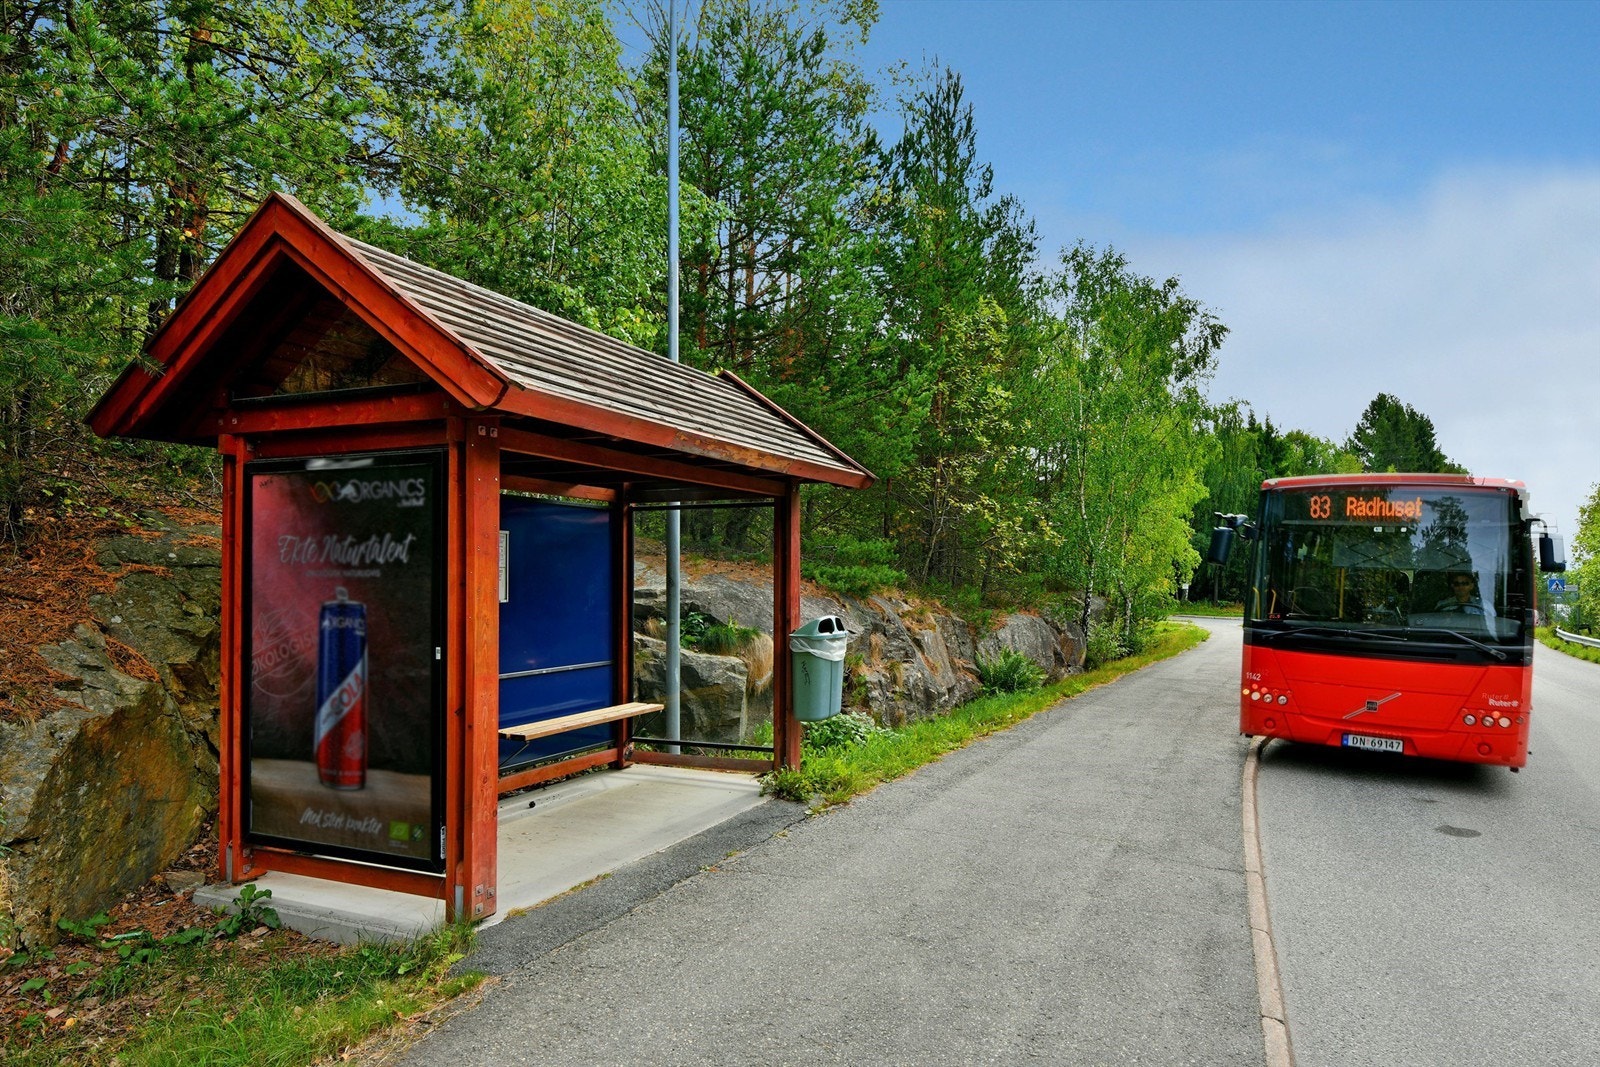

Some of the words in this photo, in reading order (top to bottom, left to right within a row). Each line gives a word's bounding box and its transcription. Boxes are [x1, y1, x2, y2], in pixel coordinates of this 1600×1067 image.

[347, 478, 425, 503] ORGANICS
[1310, 495, 1331, 519] 83
[1346, 496, 1422, 517] Rådhuset
[278, 534, 318, 565] Ekte
[319, 532, 417, 567] Naturtalent
[1246, 671, 1261, 681] 1142
[1352, 736, 1366, 747] DN
[1370, 738, 1401, 751] 69147
